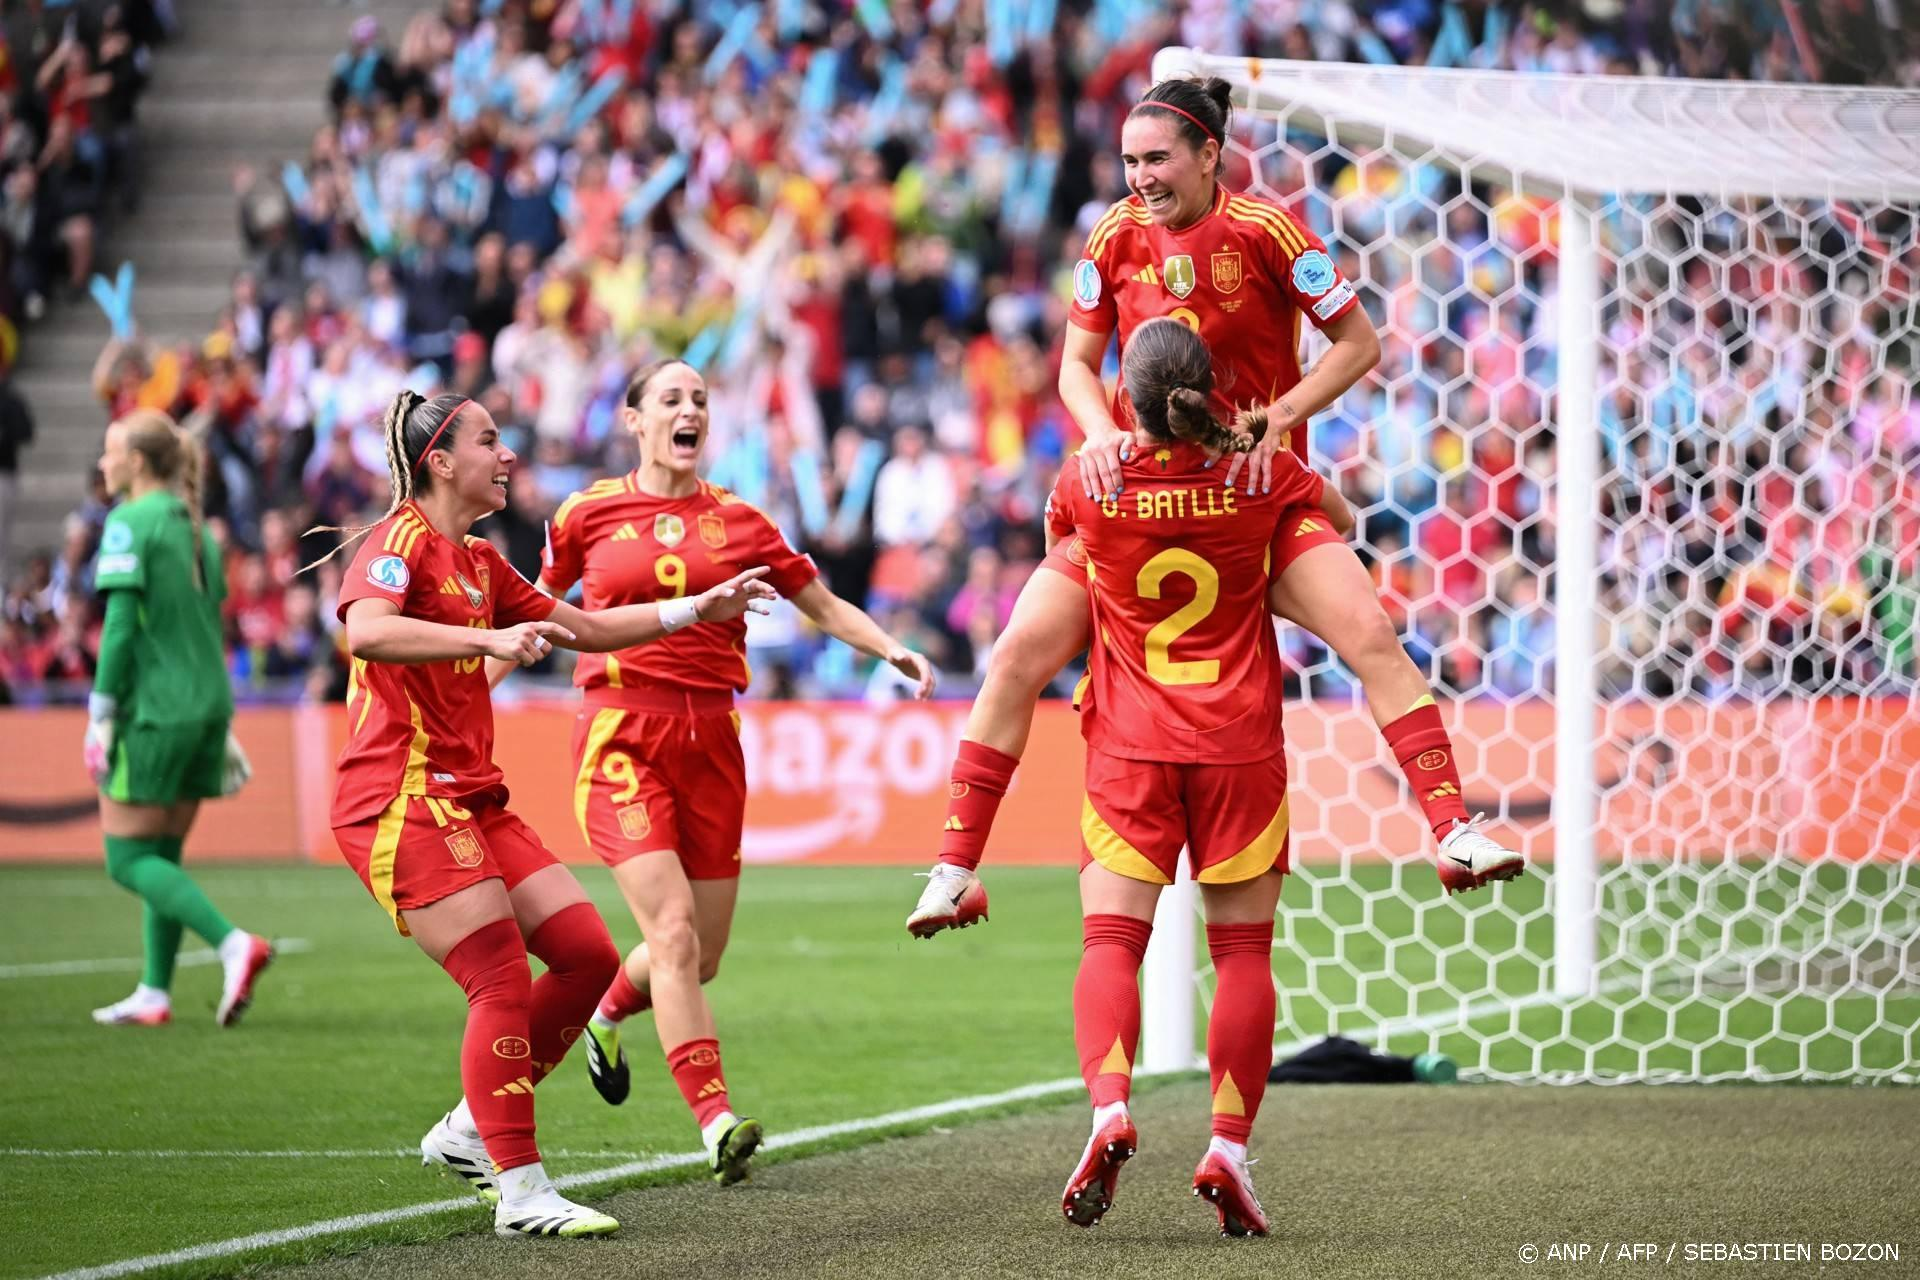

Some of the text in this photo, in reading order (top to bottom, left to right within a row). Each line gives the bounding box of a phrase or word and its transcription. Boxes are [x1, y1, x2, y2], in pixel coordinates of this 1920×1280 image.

[1136, 487, 1239, 519] BATLLE
[654, 553, 687, 602] 9
[1136, 547, 1221, 686] 2
[602, 751, 640, 804] 9
